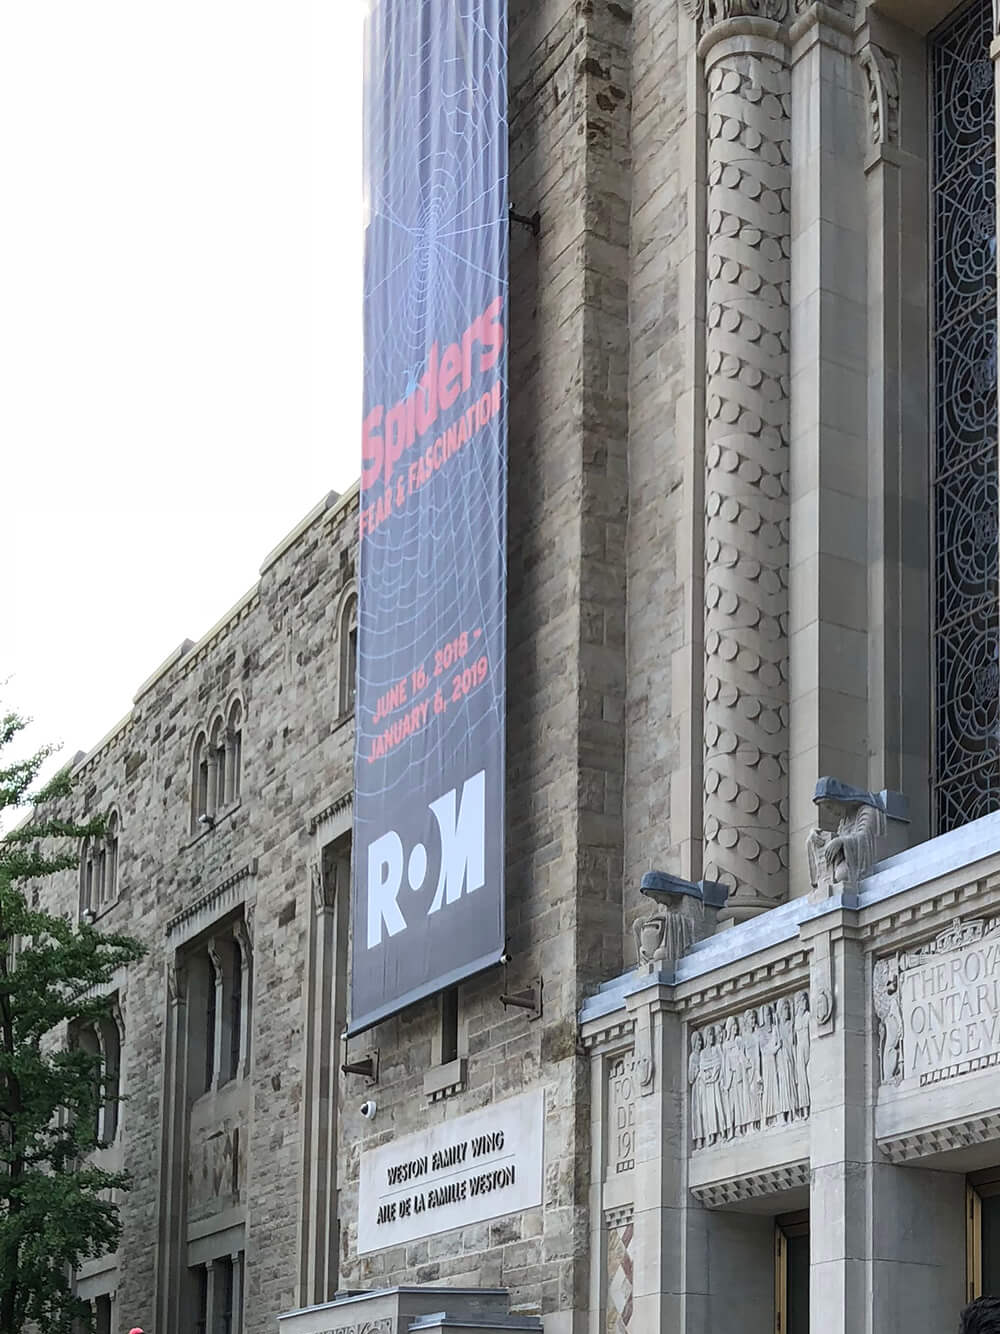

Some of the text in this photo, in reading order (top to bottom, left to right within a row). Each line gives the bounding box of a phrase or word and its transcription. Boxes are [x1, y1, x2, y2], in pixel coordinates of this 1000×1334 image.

[363, 295, 504, 491] Spiders
[360, 488, 393, 542] FEAR
[408, 379, 502, 495] FASCINATION
[372, 676, 407, 725] JUNE
[411, 662, 429, 697] 16,
[433, 631, 468, 677] 2018
[367, 698, 430, 764] JANUARY
[450, 655, 488, 703] 2019
[907, 962, 949, 1003] THE
[617, 1101, 635, 1130] DE
[617, 1129, 635, 1159] 191
[387, 1130, 506, 1186] WESTON FAMILY WING
[376, 1164, 516, 1225] AILE DE LA FAMILLE WESTON
